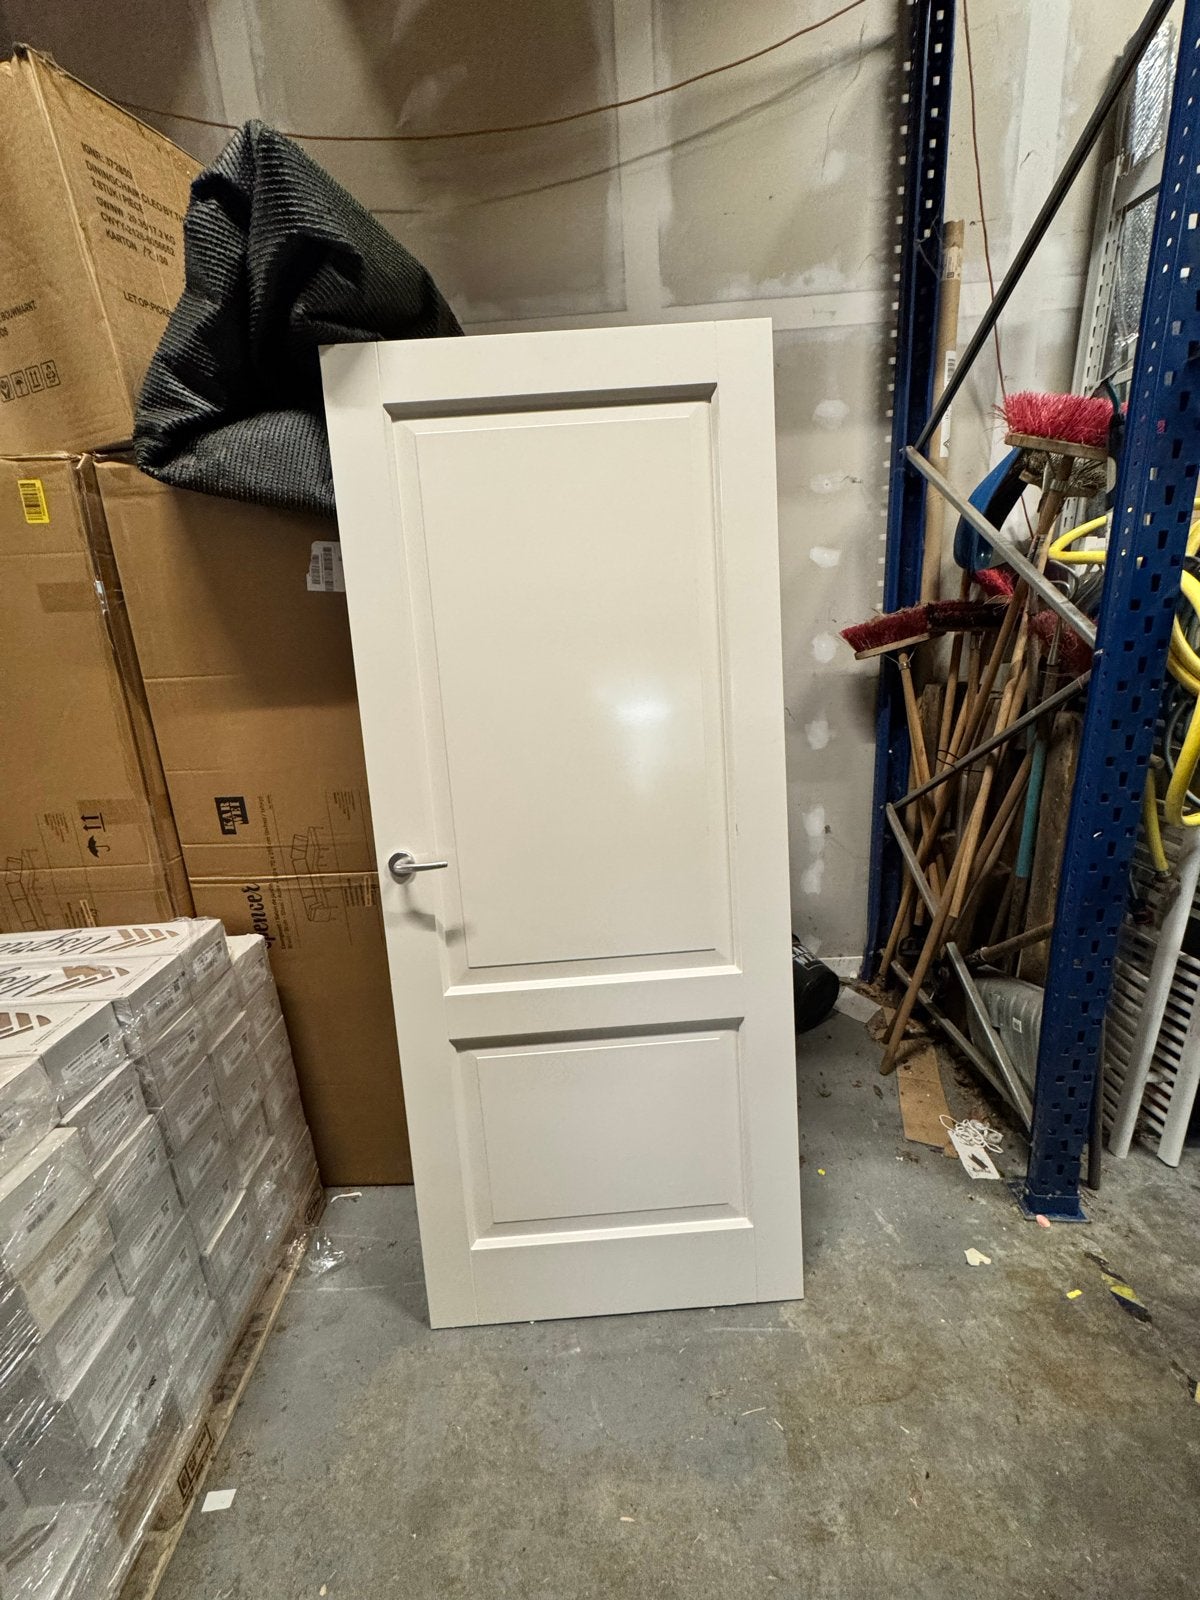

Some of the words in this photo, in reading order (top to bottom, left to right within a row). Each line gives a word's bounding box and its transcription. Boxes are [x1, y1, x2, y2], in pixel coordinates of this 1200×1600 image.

[105, 228, 138, 252] KARTON
[123, 291, 137, 304] LET
[220, 802, 235, 831] KAR
[228, 801, 244, 825] WEI
[241, 883, 276, 950] pencer
